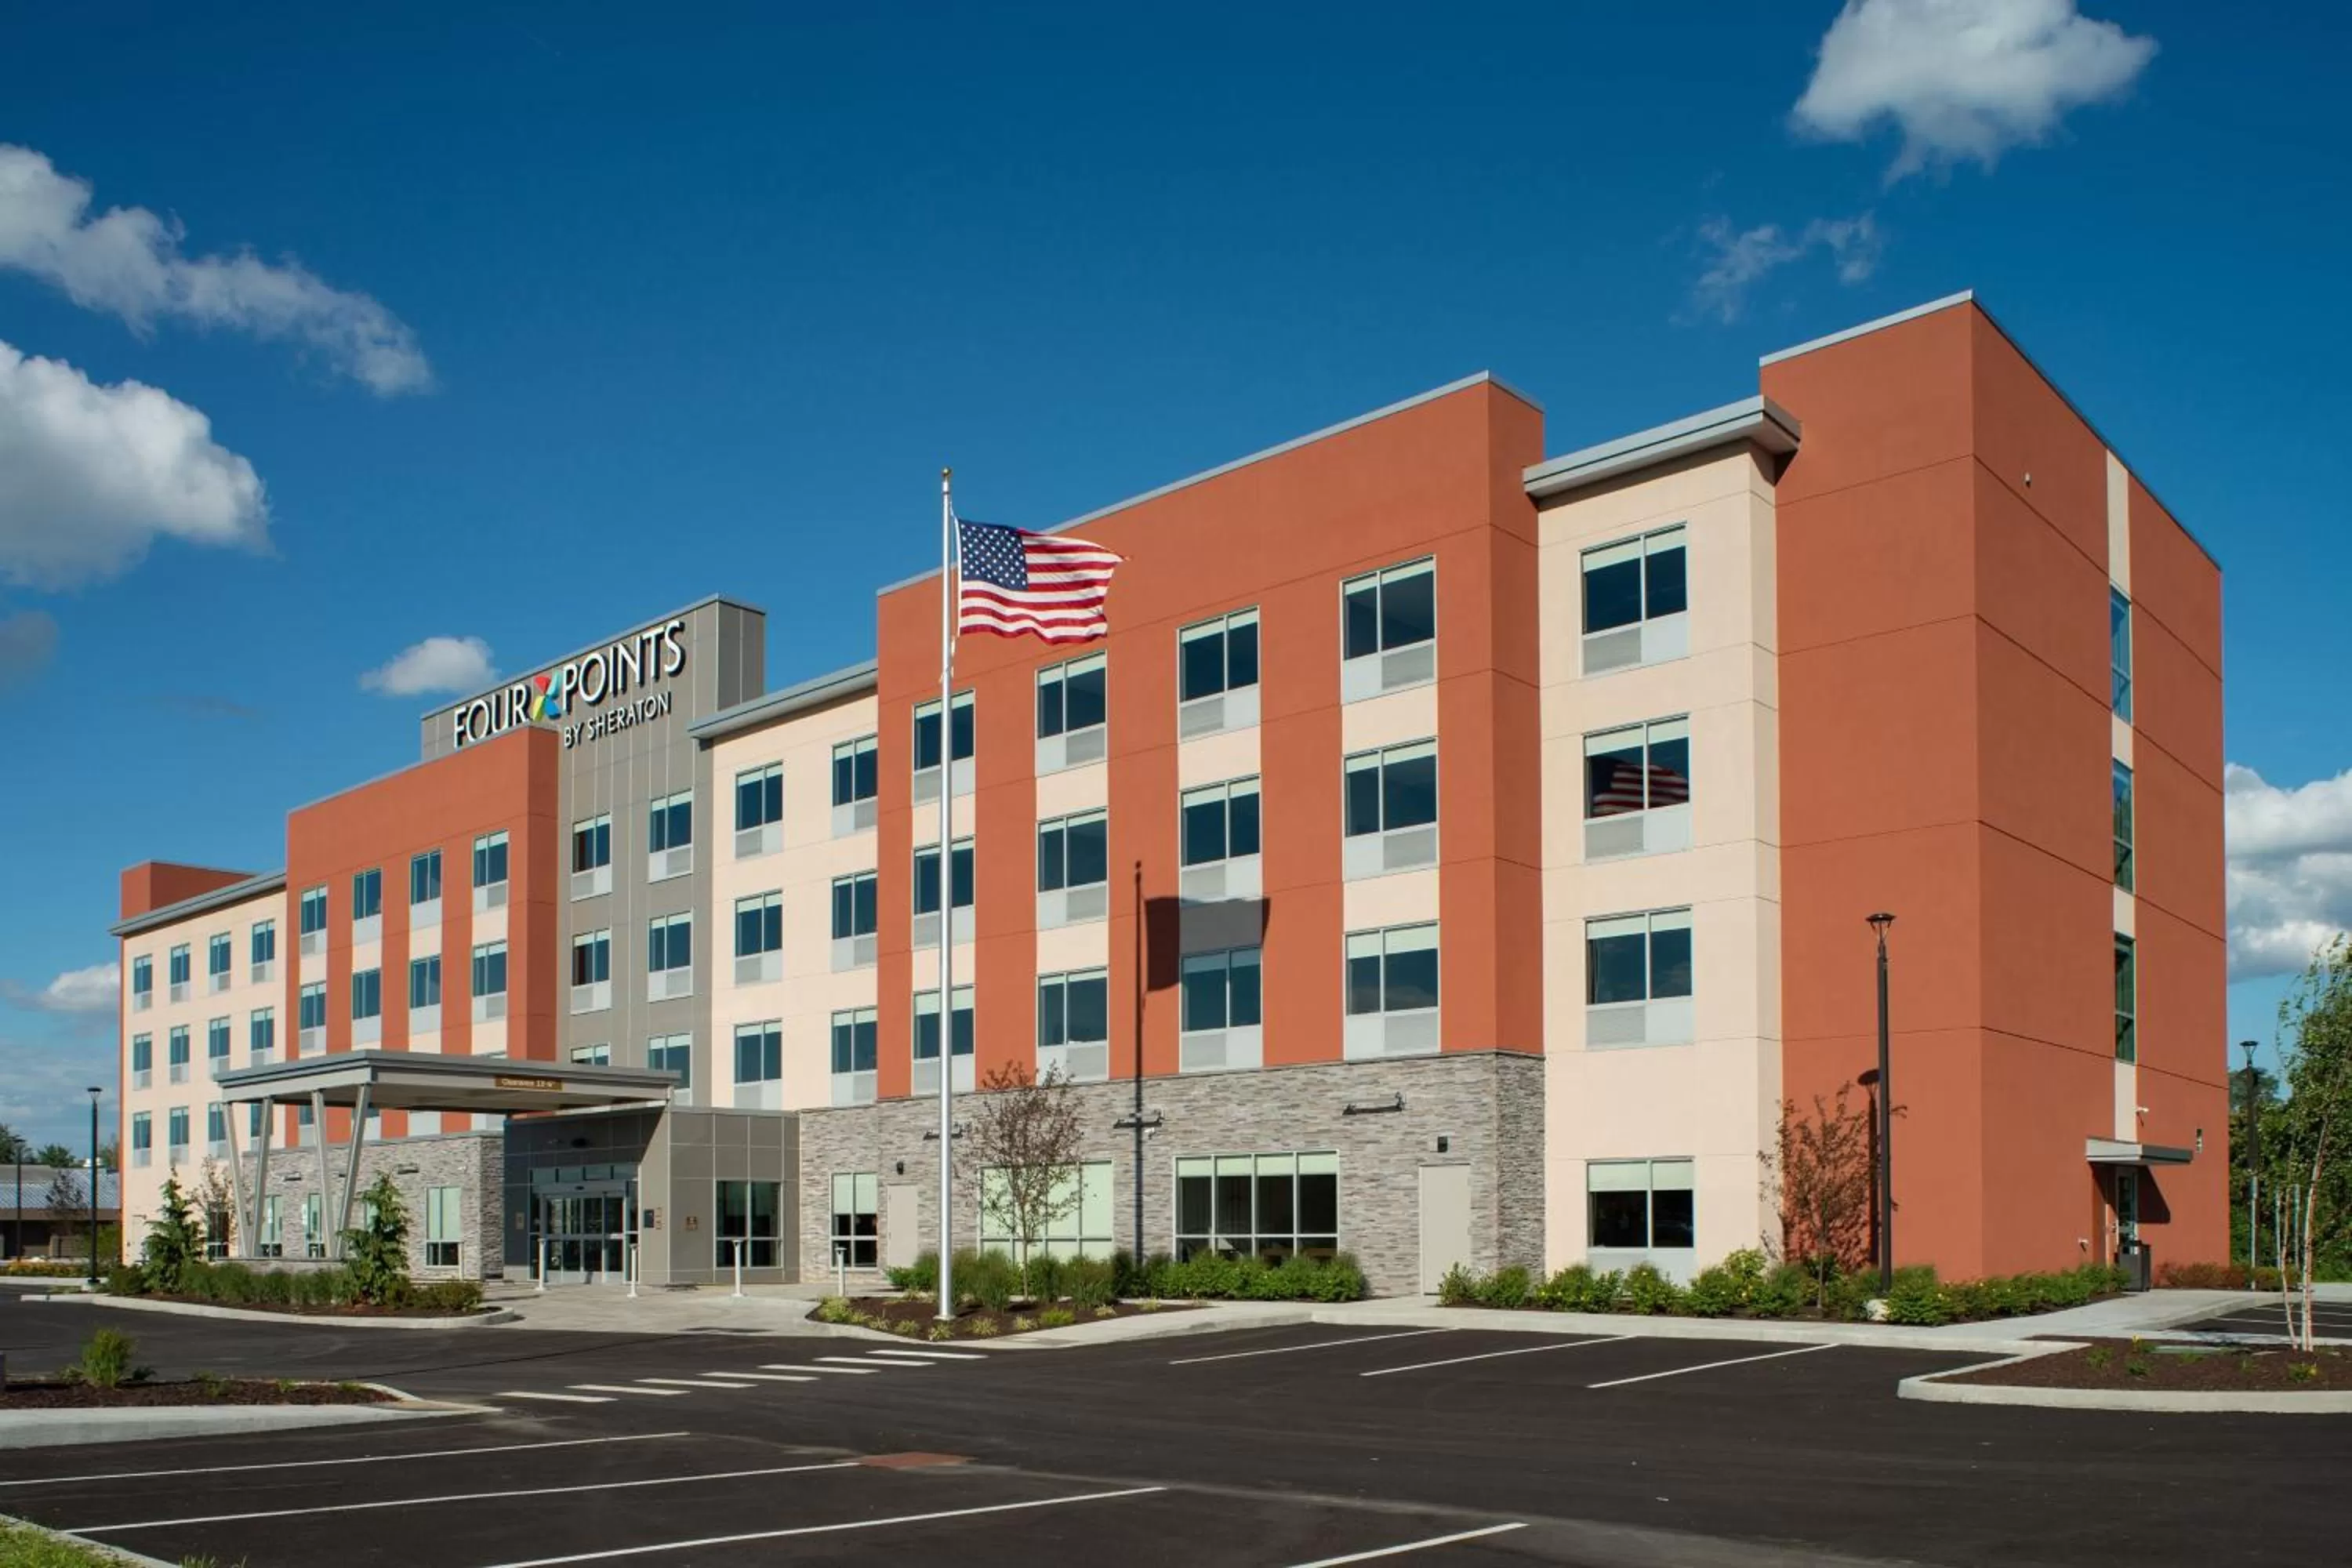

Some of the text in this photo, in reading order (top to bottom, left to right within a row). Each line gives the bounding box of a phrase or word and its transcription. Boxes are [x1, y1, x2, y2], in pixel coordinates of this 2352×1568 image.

[453, 621, 684, 750] FOUR POINTS
[564, 691, 671, 748] BY SHERATON
